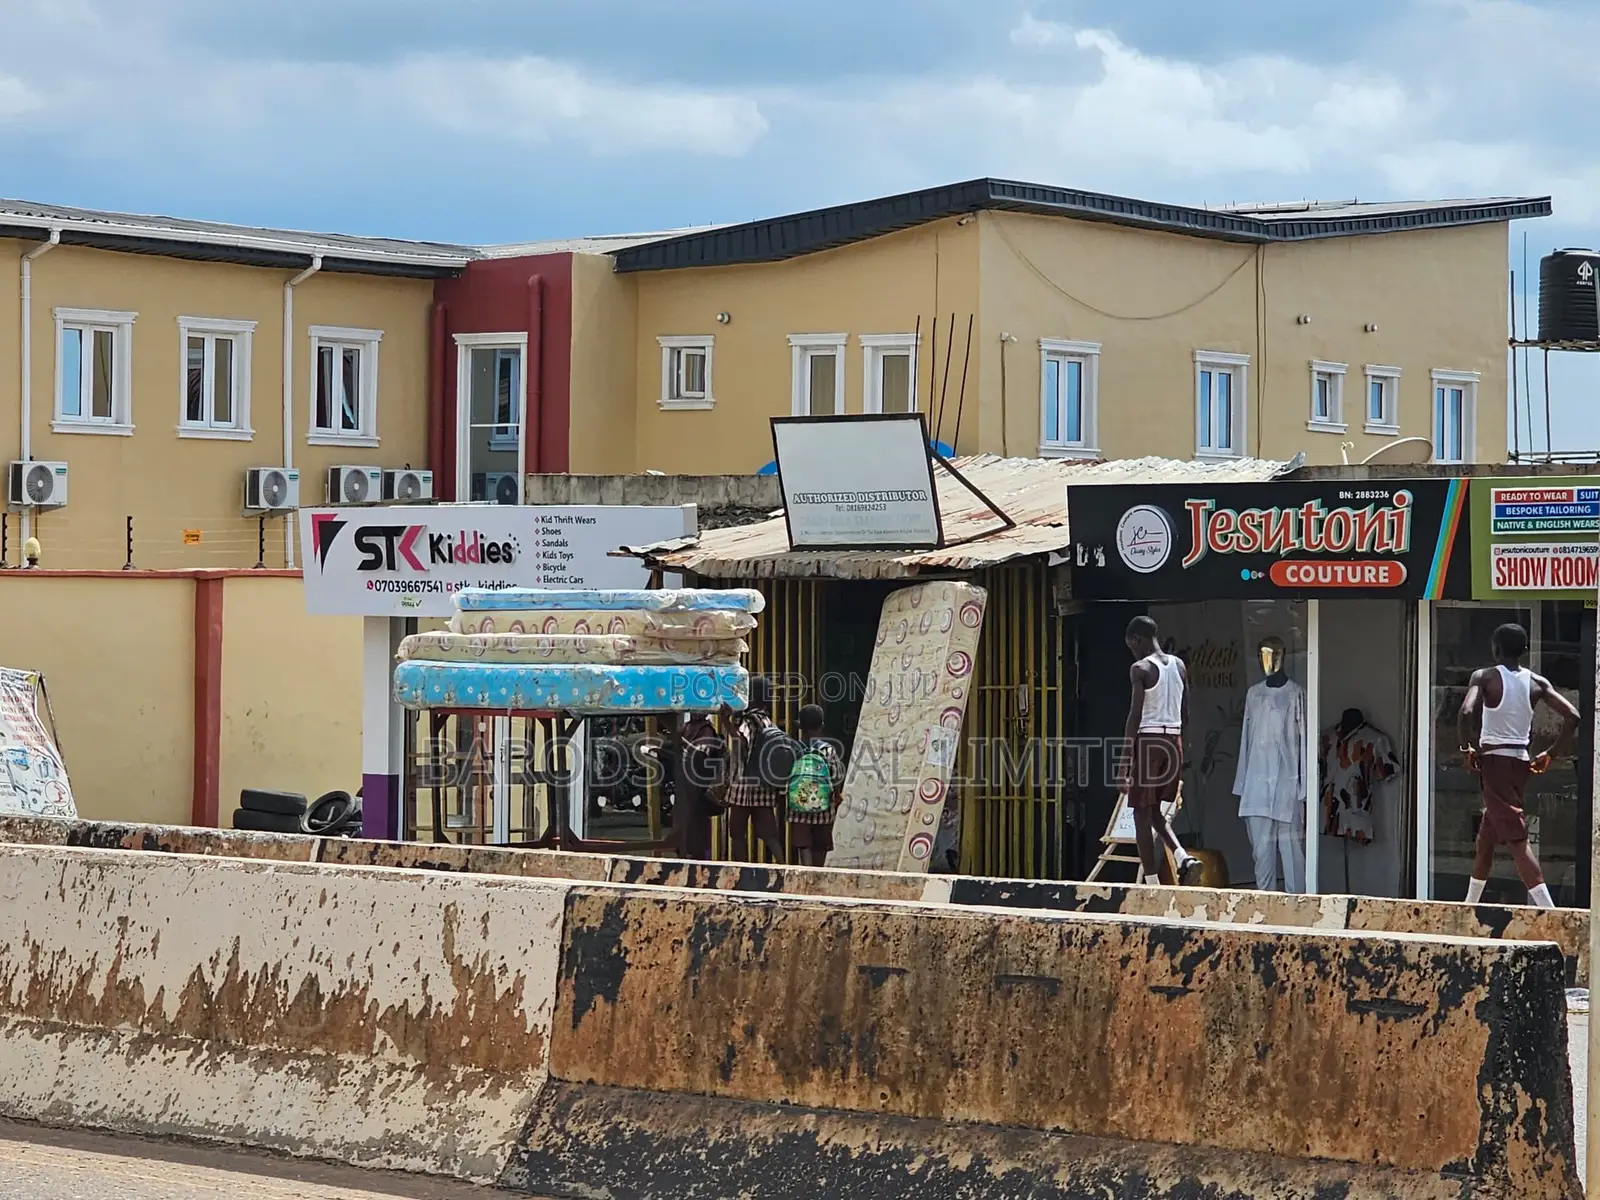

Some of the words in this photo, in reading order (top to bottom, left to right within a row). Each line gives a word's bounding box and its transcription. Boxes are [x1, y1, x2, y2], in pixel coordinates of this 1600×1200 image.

[793, 492, 856, 503] AUTHORIZED
[858, 490, 927, 502] DISTRIBUTOR
[1339, 491, 1354, 499] BN:
[1355, 491, 1389, 499] 2883236
[1530, 492, 1541, 500] TO
[1543, 492, 1567, 500] WEAR
[1506, 507, 1543, 515] BESPOKE
[1545, 505, 1591, 514] TAILORING
[541, 516, 553, 524] Kid
[554, 516, 573, 524] Thrift
[575, 516, 596, 524] Wears
[1497, 521, 1526, 530] NATIVE
[1527, 521, 1533, 529] &
[1535, 519, 1571, 529] ENGLISH
[1572, 519, 1599, 528] WEARS
[541, 527, 562, 535] Shoes
[1182, 489, 1414, 569] Jesutoni
[354, 524, 429, 571] STK
[428, 530, 515, 565] Kiddies
[542, 539, 568, 547] Sandals
[542, 551, 557, 559] Kids
[559, 551, 574, 561] Toys
[542, 563, 566, 573] Bicycle
[1496, 557, 1547, 586] SHOW
[1551, 557, 1598, 586] ROOM
[1286, 565, 1390, 583] COUTURE
[543, 575, 567, 583] Electric
[569, 575, 583, 584] Cars
[374, 580, 443, 593] 07039667541
